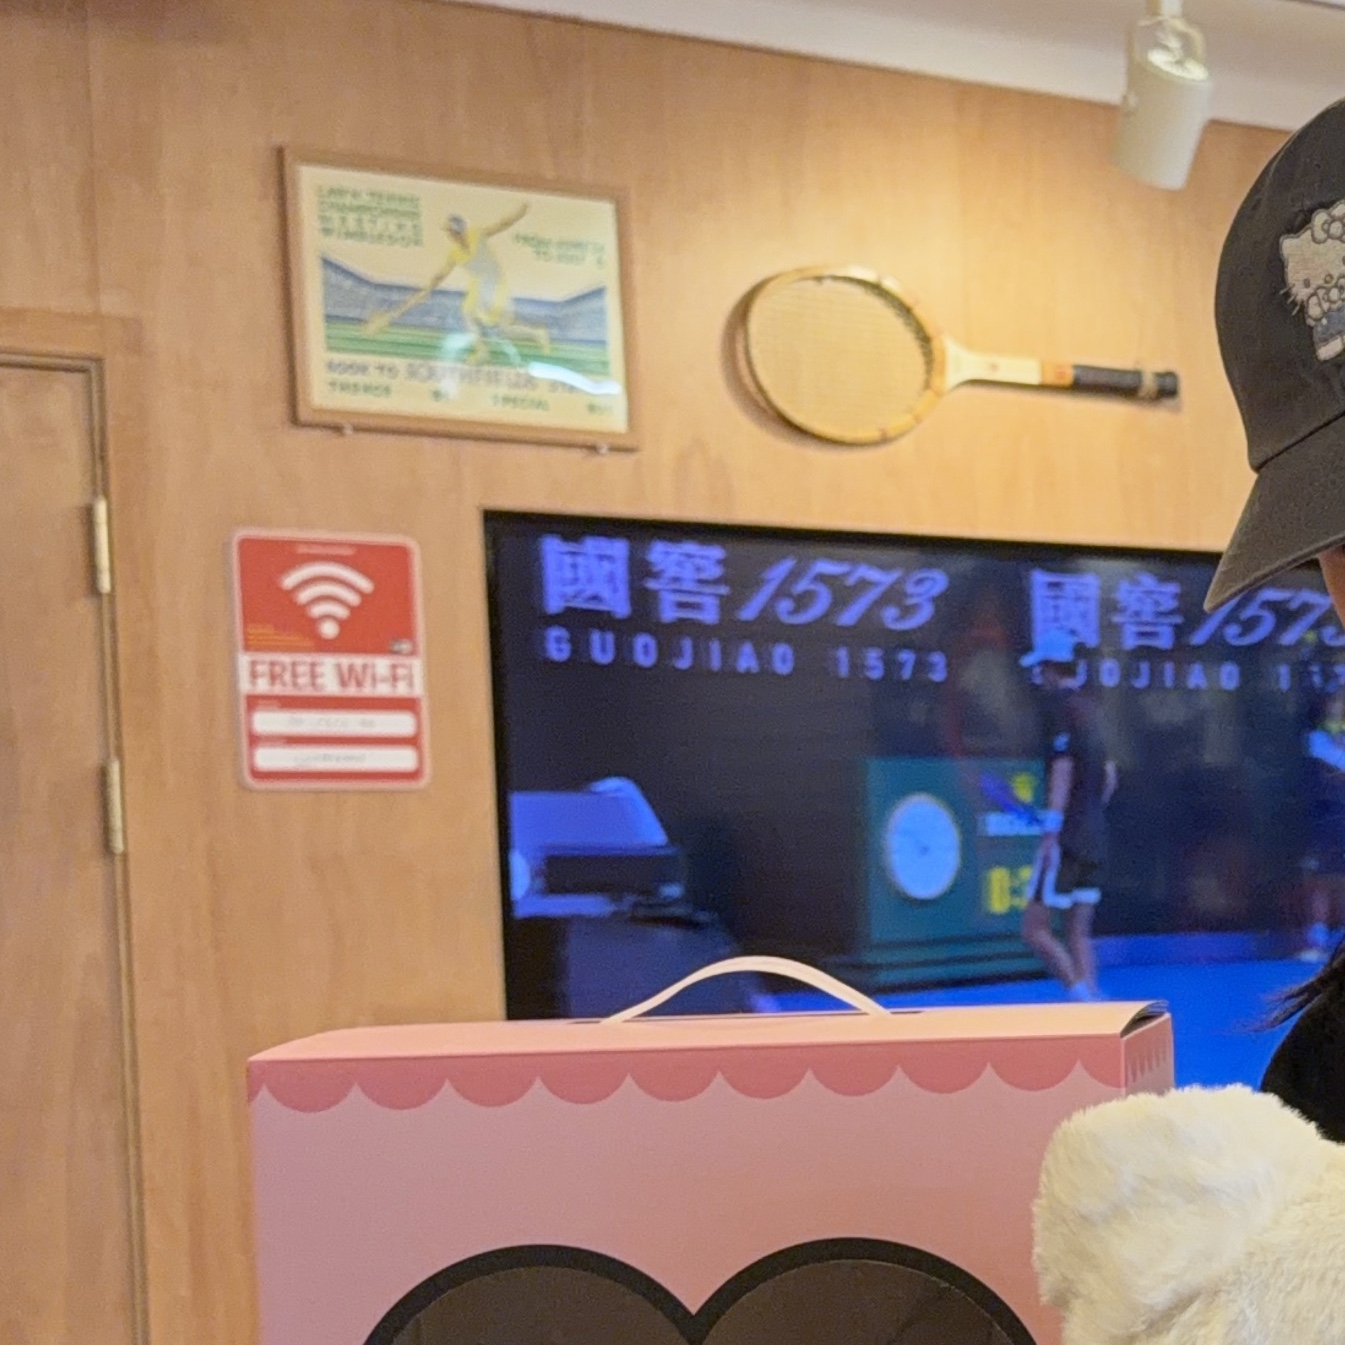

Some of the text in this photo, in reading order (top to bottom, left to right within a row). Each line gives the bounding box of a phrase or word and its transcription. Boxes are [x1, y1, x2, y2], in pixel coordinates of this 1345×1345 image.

[249, 659, 325, 692] FREE
[545, 625, 948, 682] GUOJIAO 1573
